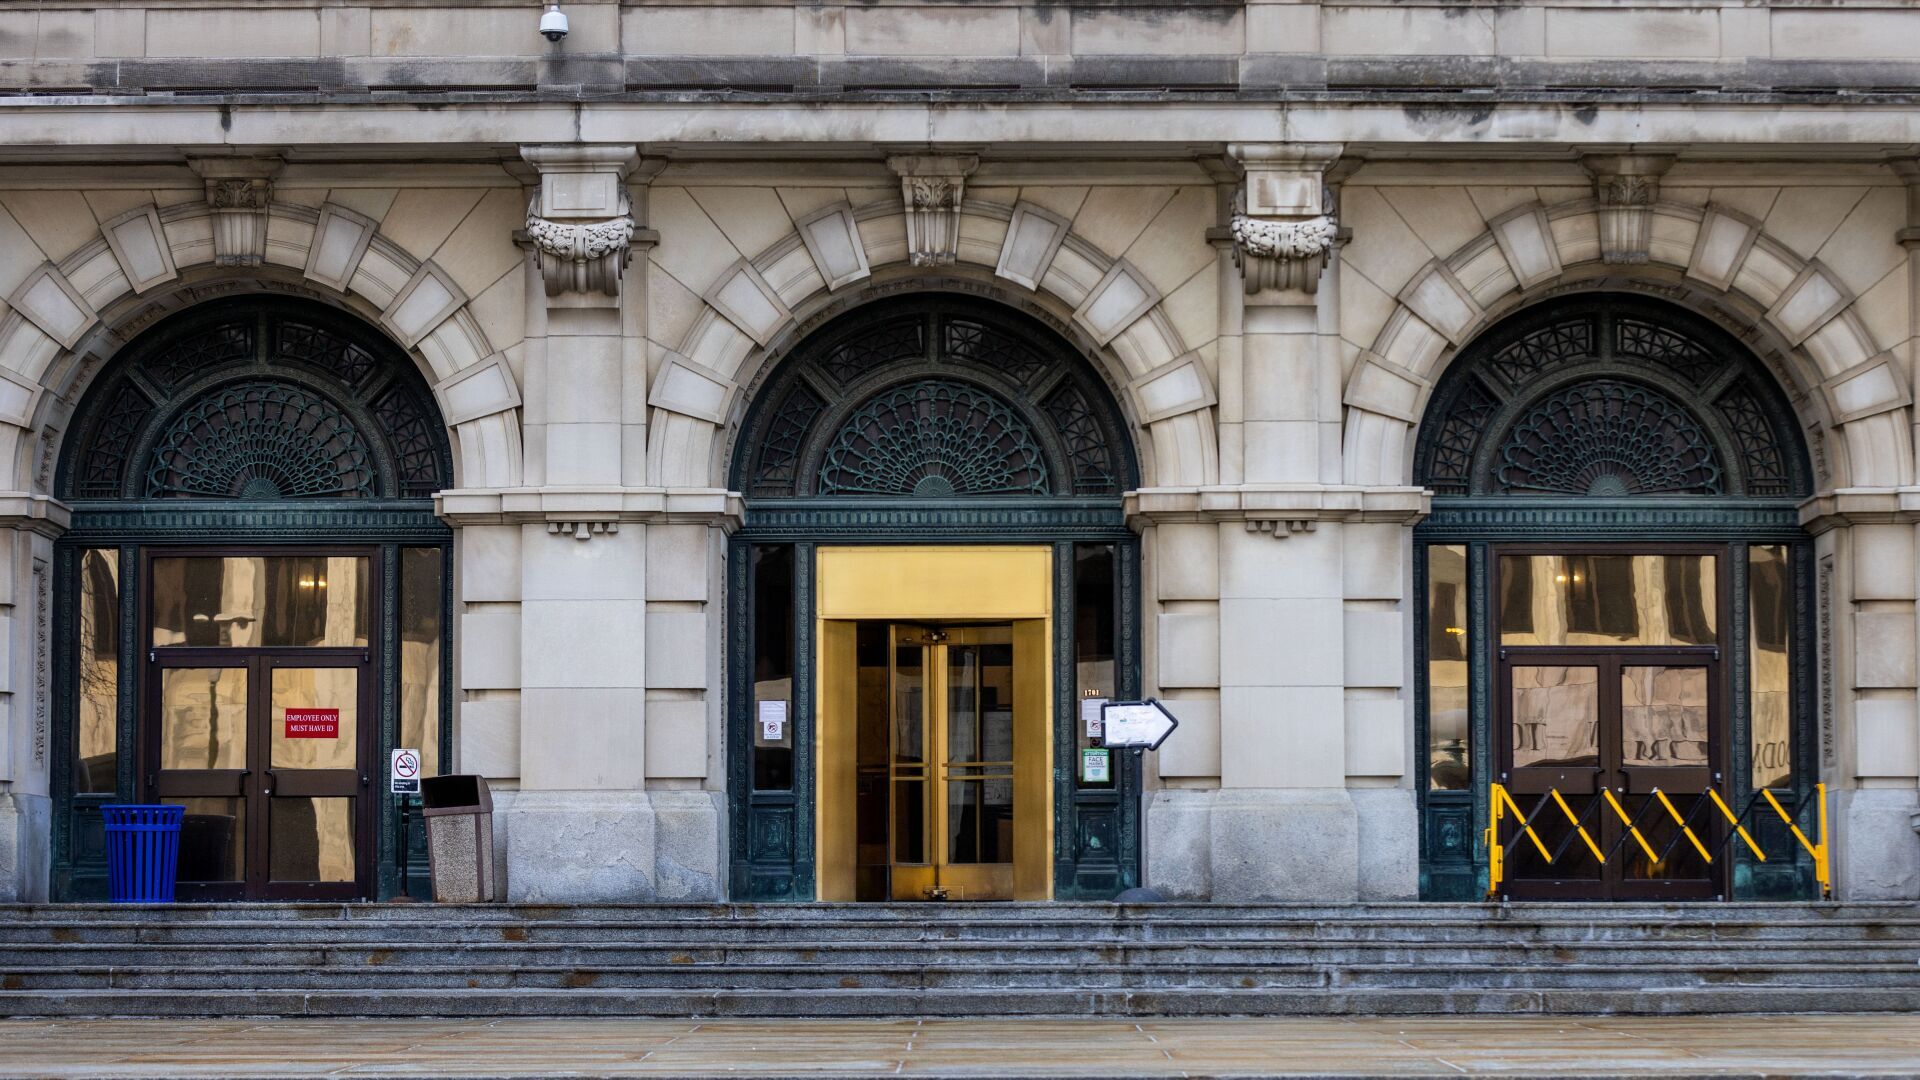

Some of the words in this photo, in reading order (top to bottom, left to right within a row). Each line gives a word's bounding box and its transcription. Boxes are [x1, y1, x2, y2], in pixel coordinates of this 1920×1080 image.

[290, 724, 309, 732] MUST
[309, 724, 326, 732] HAVE
[326, 724, 334, 732] ID
